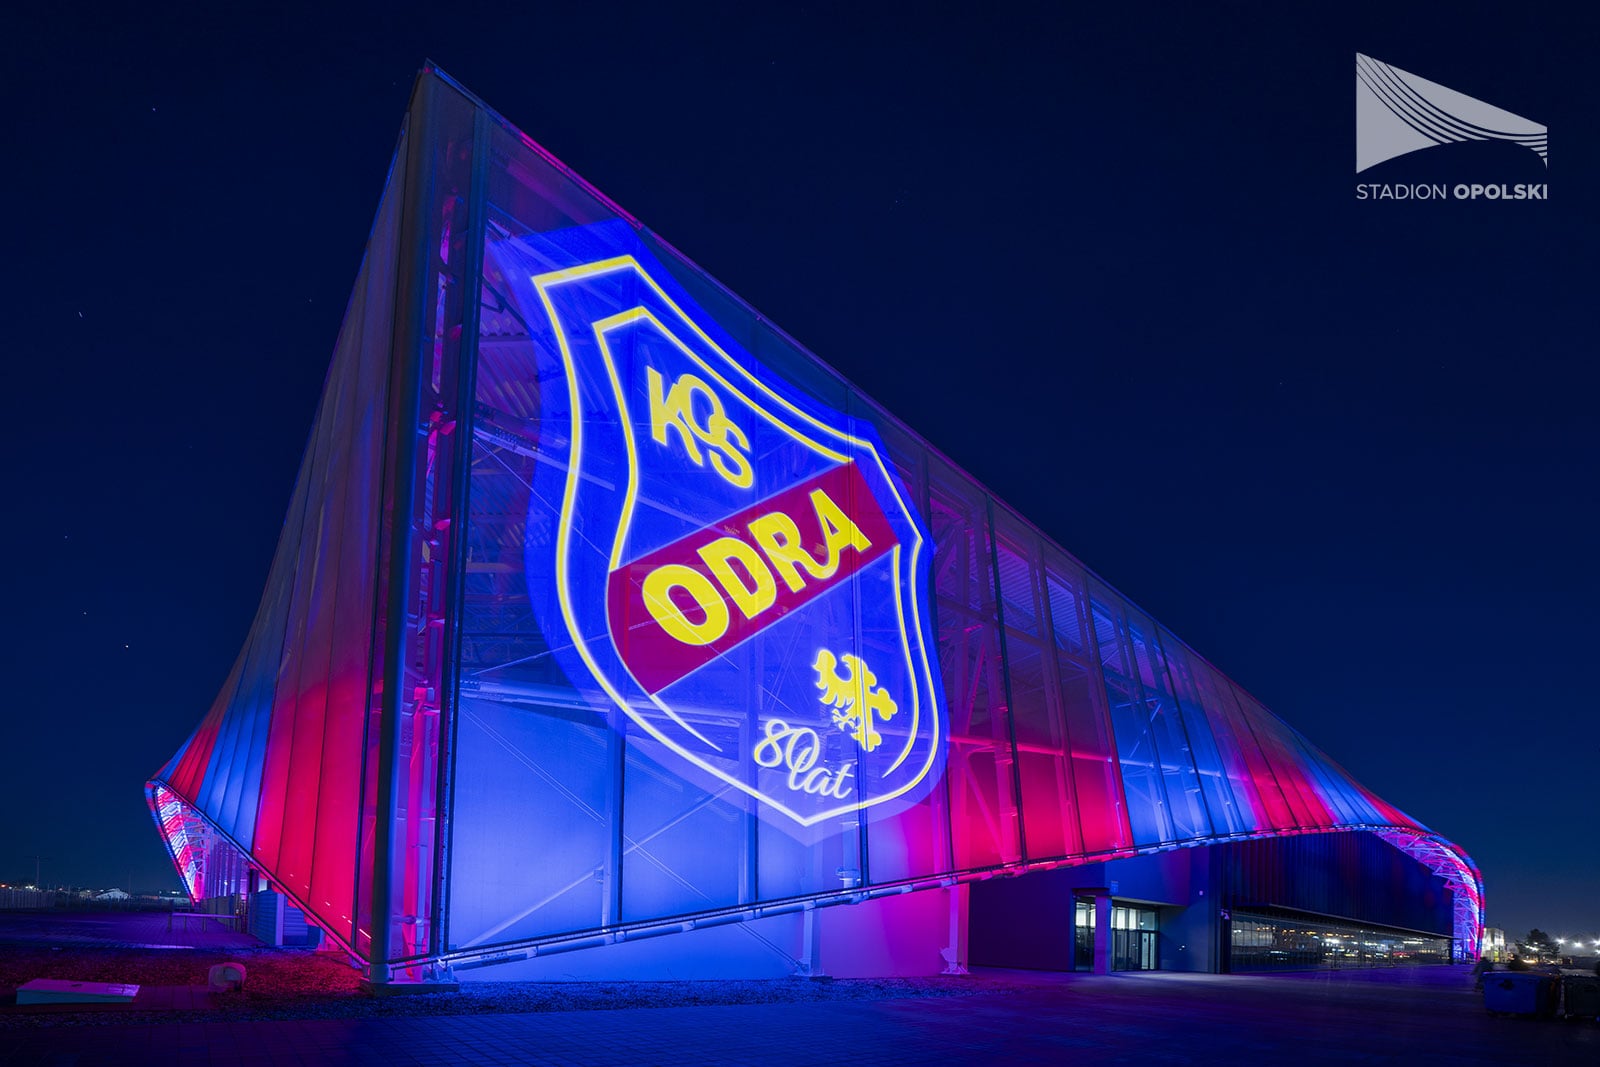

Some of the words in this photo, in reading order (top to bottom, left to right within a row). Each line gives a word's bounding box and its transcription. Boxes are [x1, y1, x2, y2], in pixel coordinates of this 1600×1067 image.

[642, 488, 873, 646] ODRA
[754, 719, 820, 773] 80
[788, 747, 855, 799] lat
